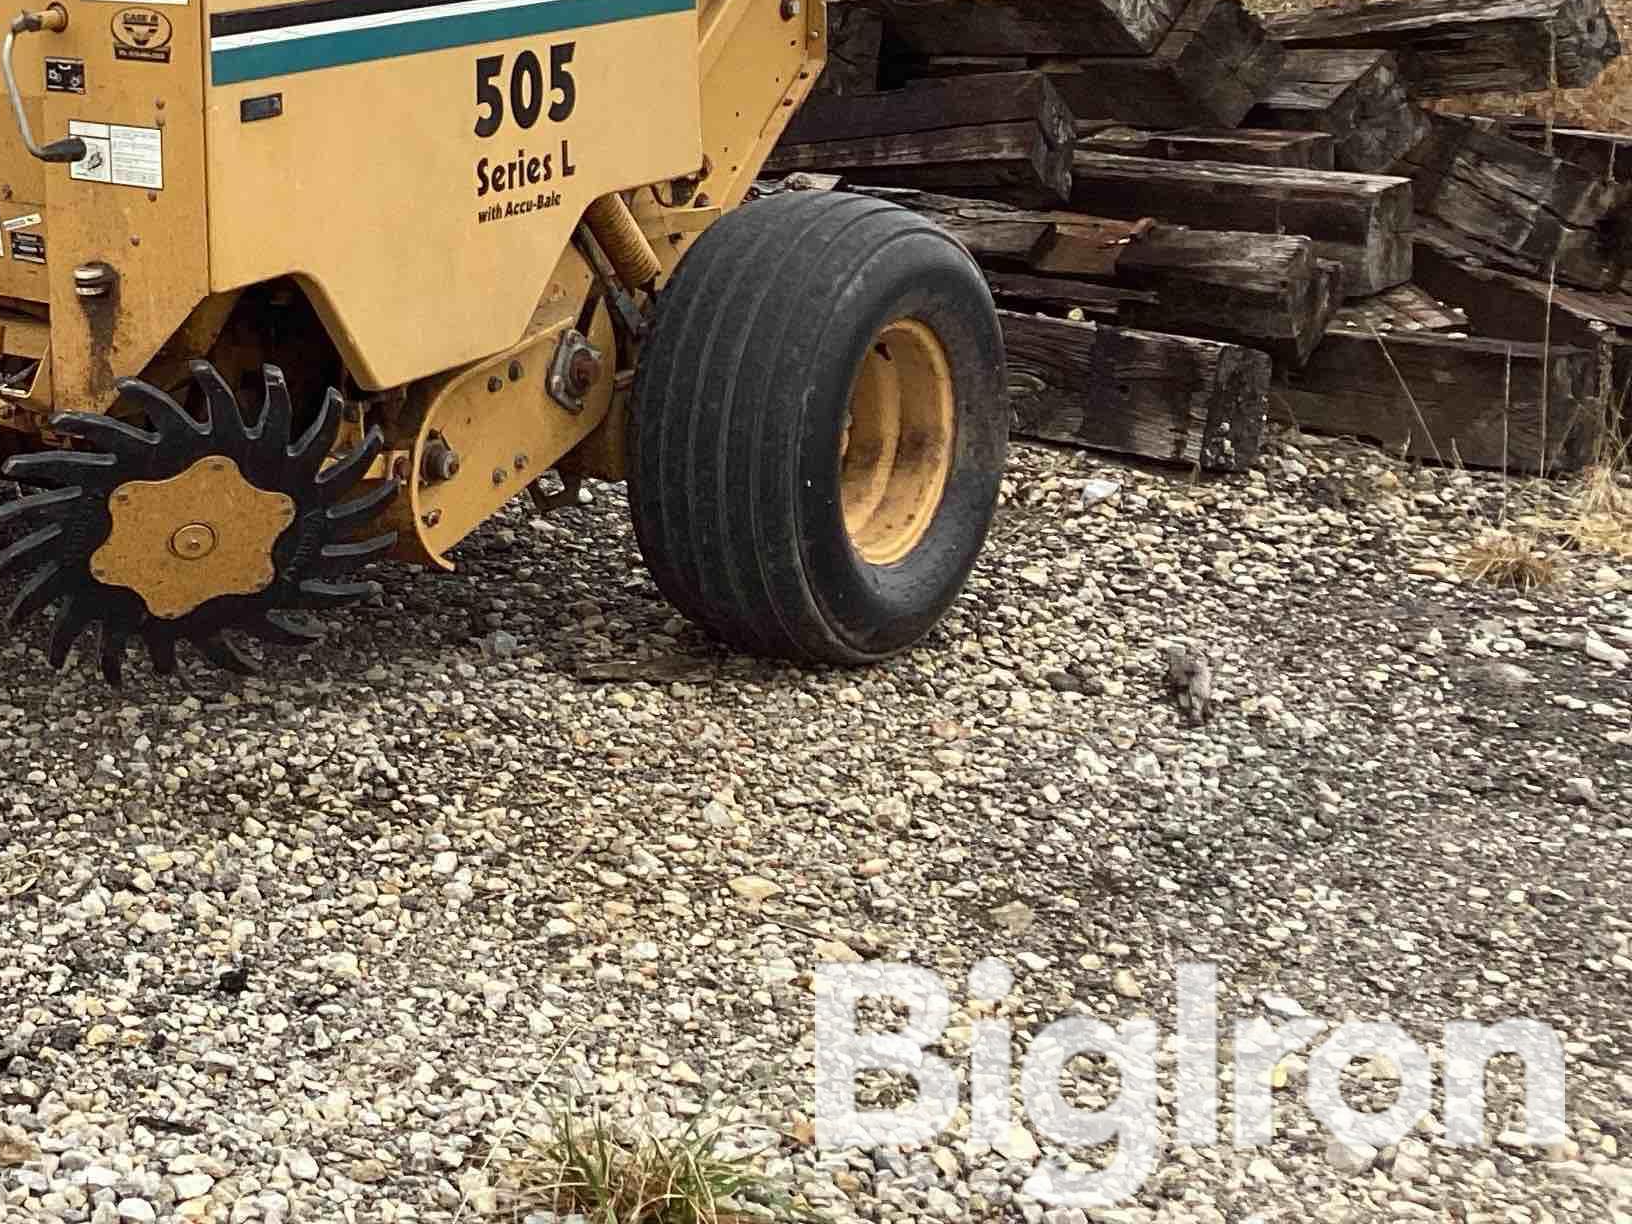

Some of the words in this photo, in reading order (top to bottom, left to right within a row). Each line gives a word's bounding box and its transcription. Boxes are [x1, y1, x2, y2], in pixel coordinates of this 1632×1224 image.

[473, 41, 576, 139] 505
[477, 148, 552, 198] Series
[561, 139, 576, 177] L
[478, 202, 503, 225] with
[505, 190, 562, 219] Accu-Bale
